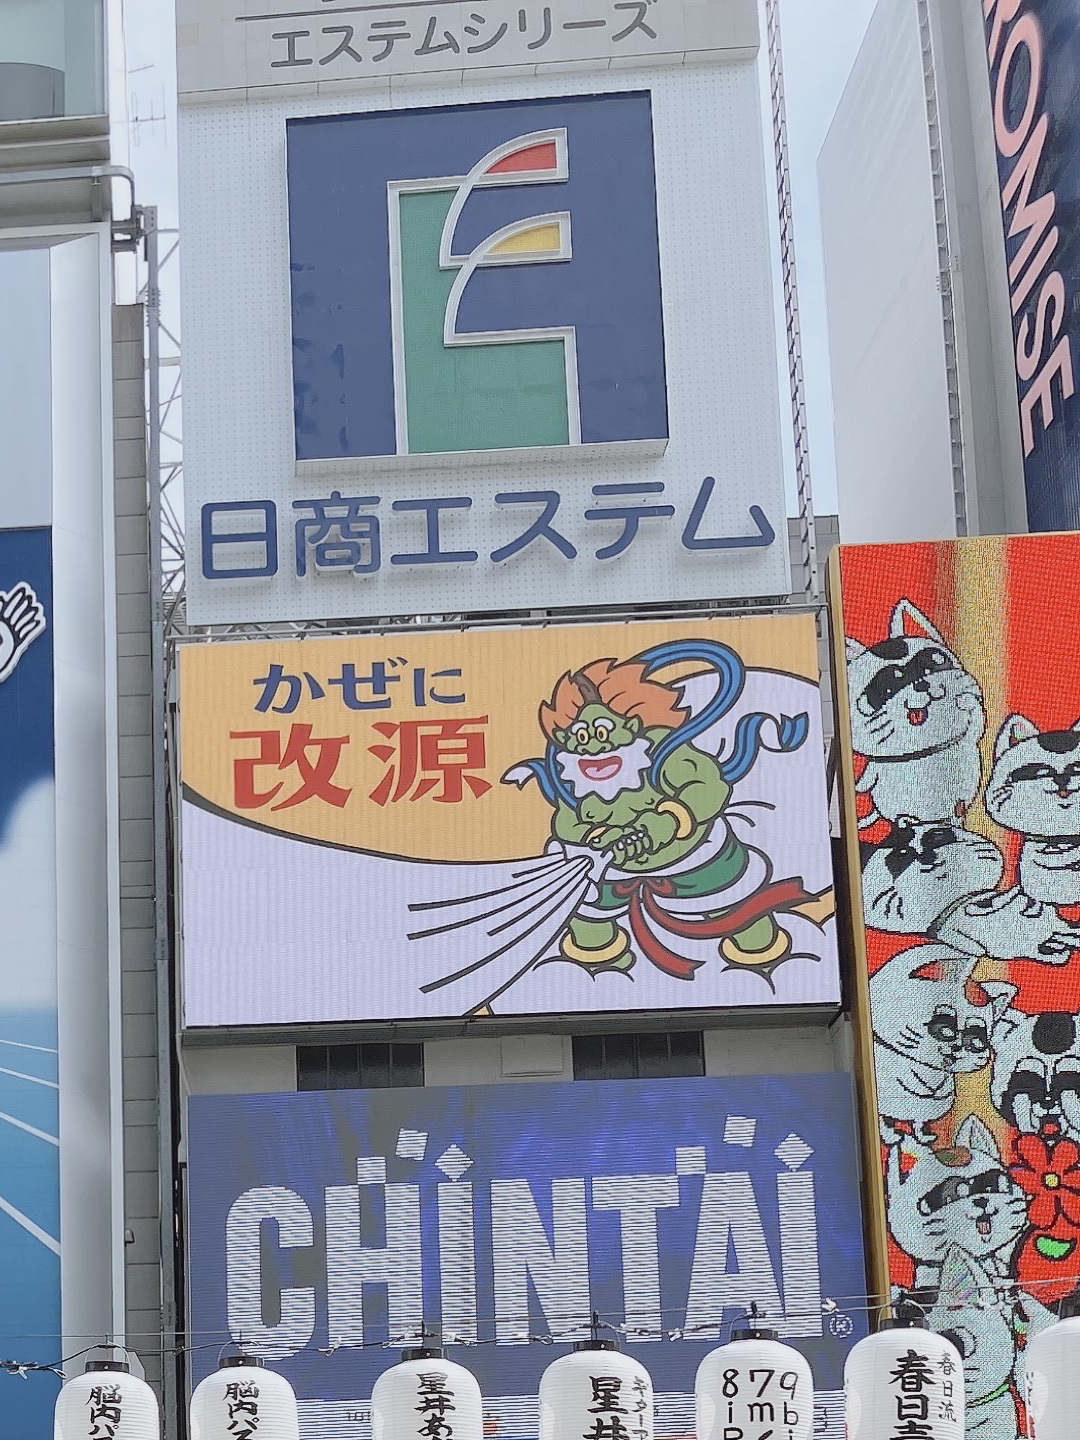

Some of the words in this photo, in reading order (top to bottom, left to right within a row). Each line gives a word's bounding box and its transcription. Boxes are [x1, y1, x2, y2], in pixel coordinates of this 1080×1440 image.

[270, 0, 658, 67] エステムシリーズ
[200, 476, 776, 580] 日商エステム
[252, 657, 466, 714] かぜに
[229, 714, 493, 811] 改源
